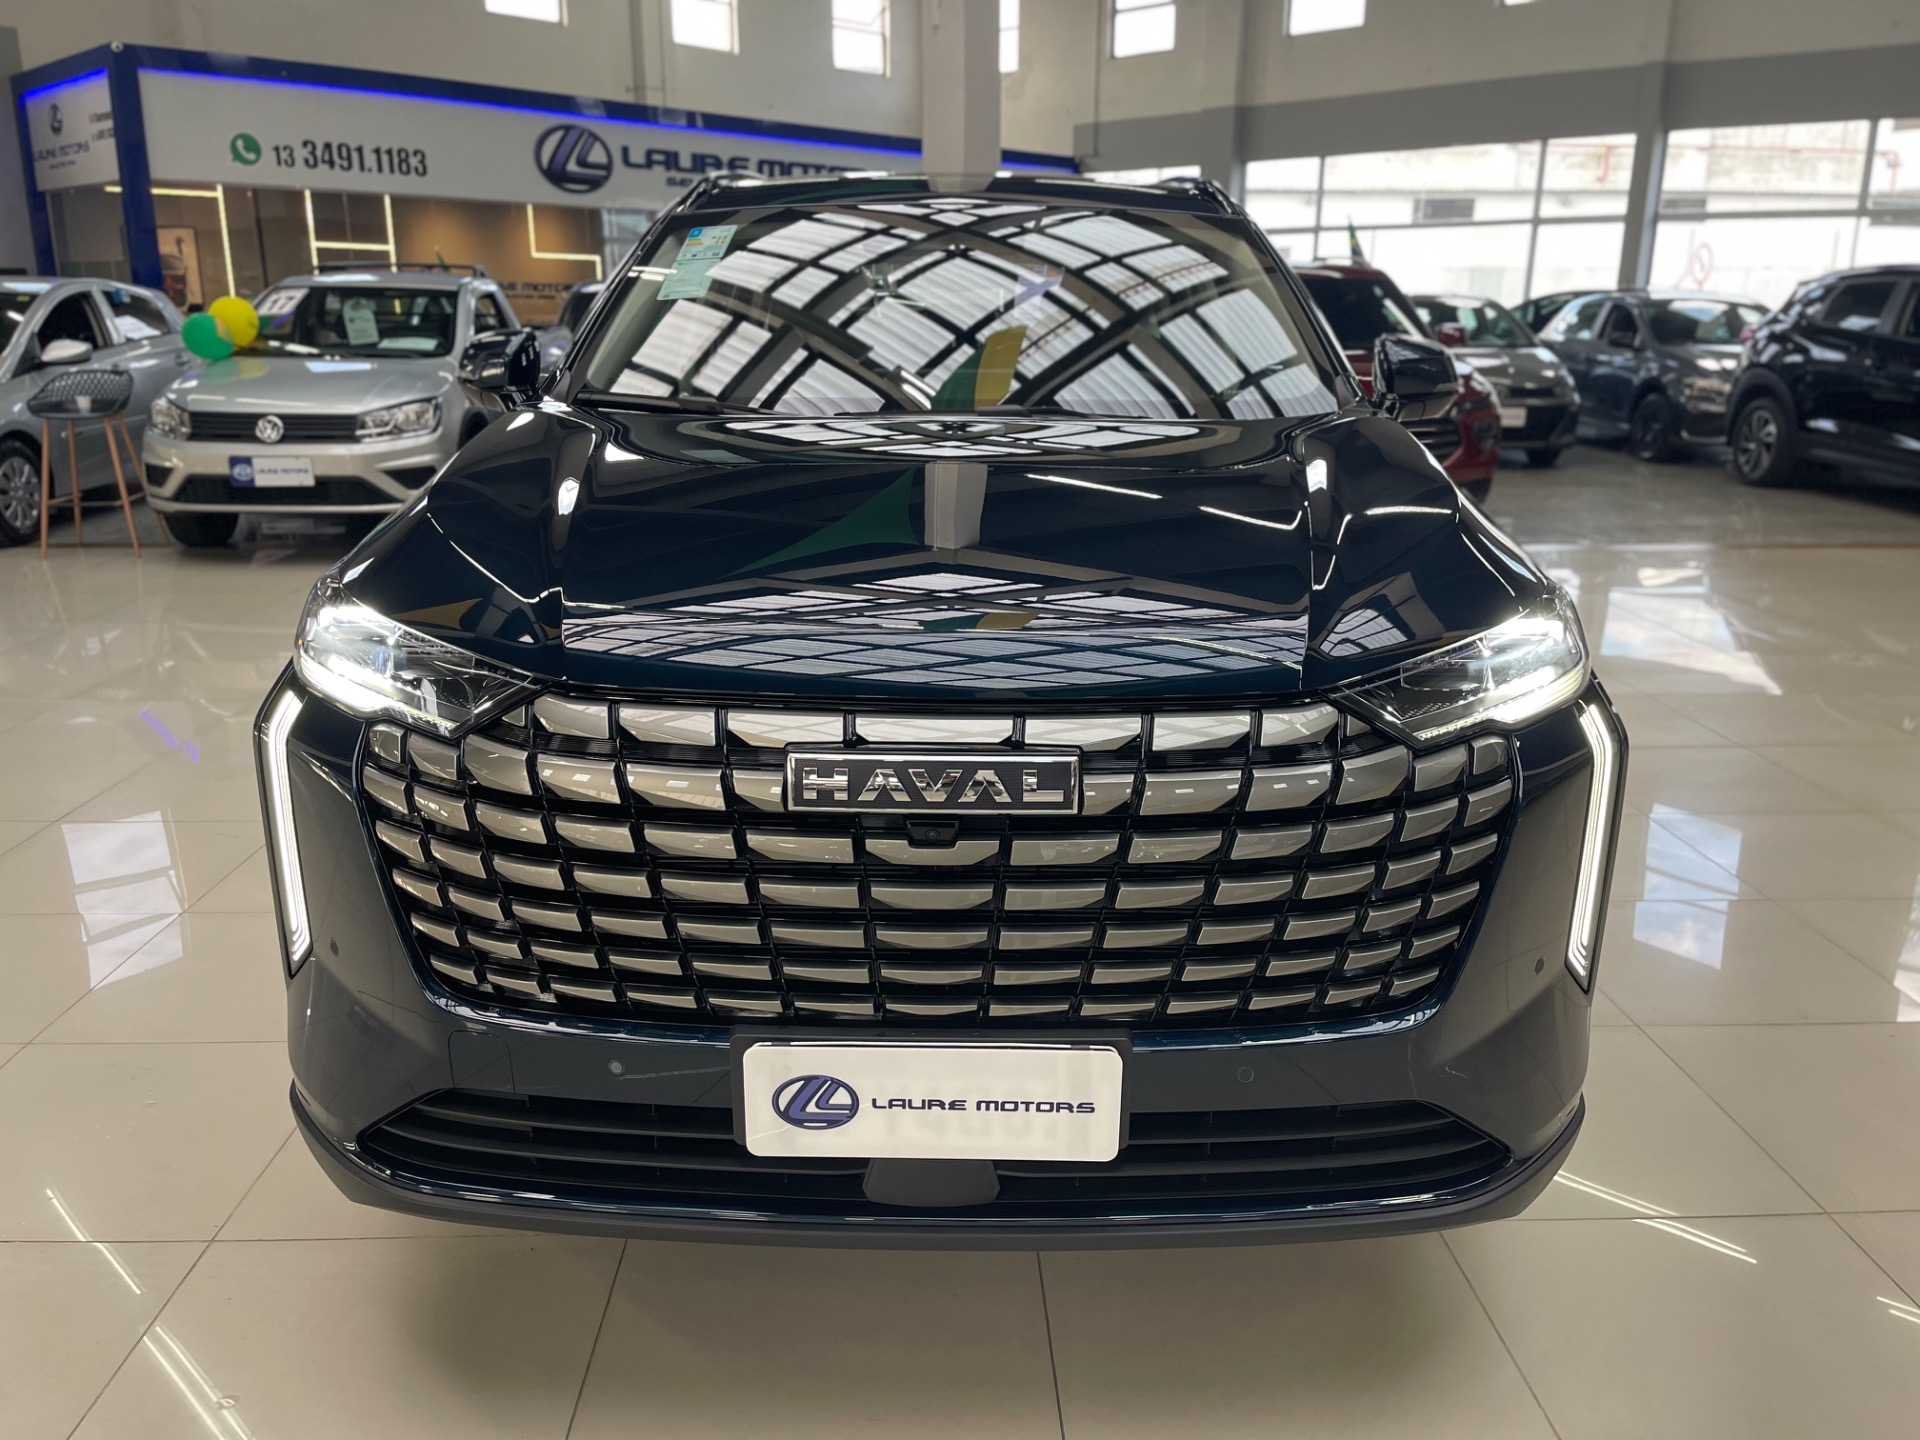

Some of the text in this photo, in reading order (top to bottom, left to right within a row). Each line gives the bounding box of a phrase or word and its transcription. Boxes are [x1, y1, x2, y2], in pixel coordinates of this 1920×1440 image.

[272, 139, 428, 178] 13 3491.1183
[620, 145, 751, 174] LAURE
[802, 766, 1065, 803] HAVAL
[871, 1097, 1096, 1114] LAURE MOTORS
